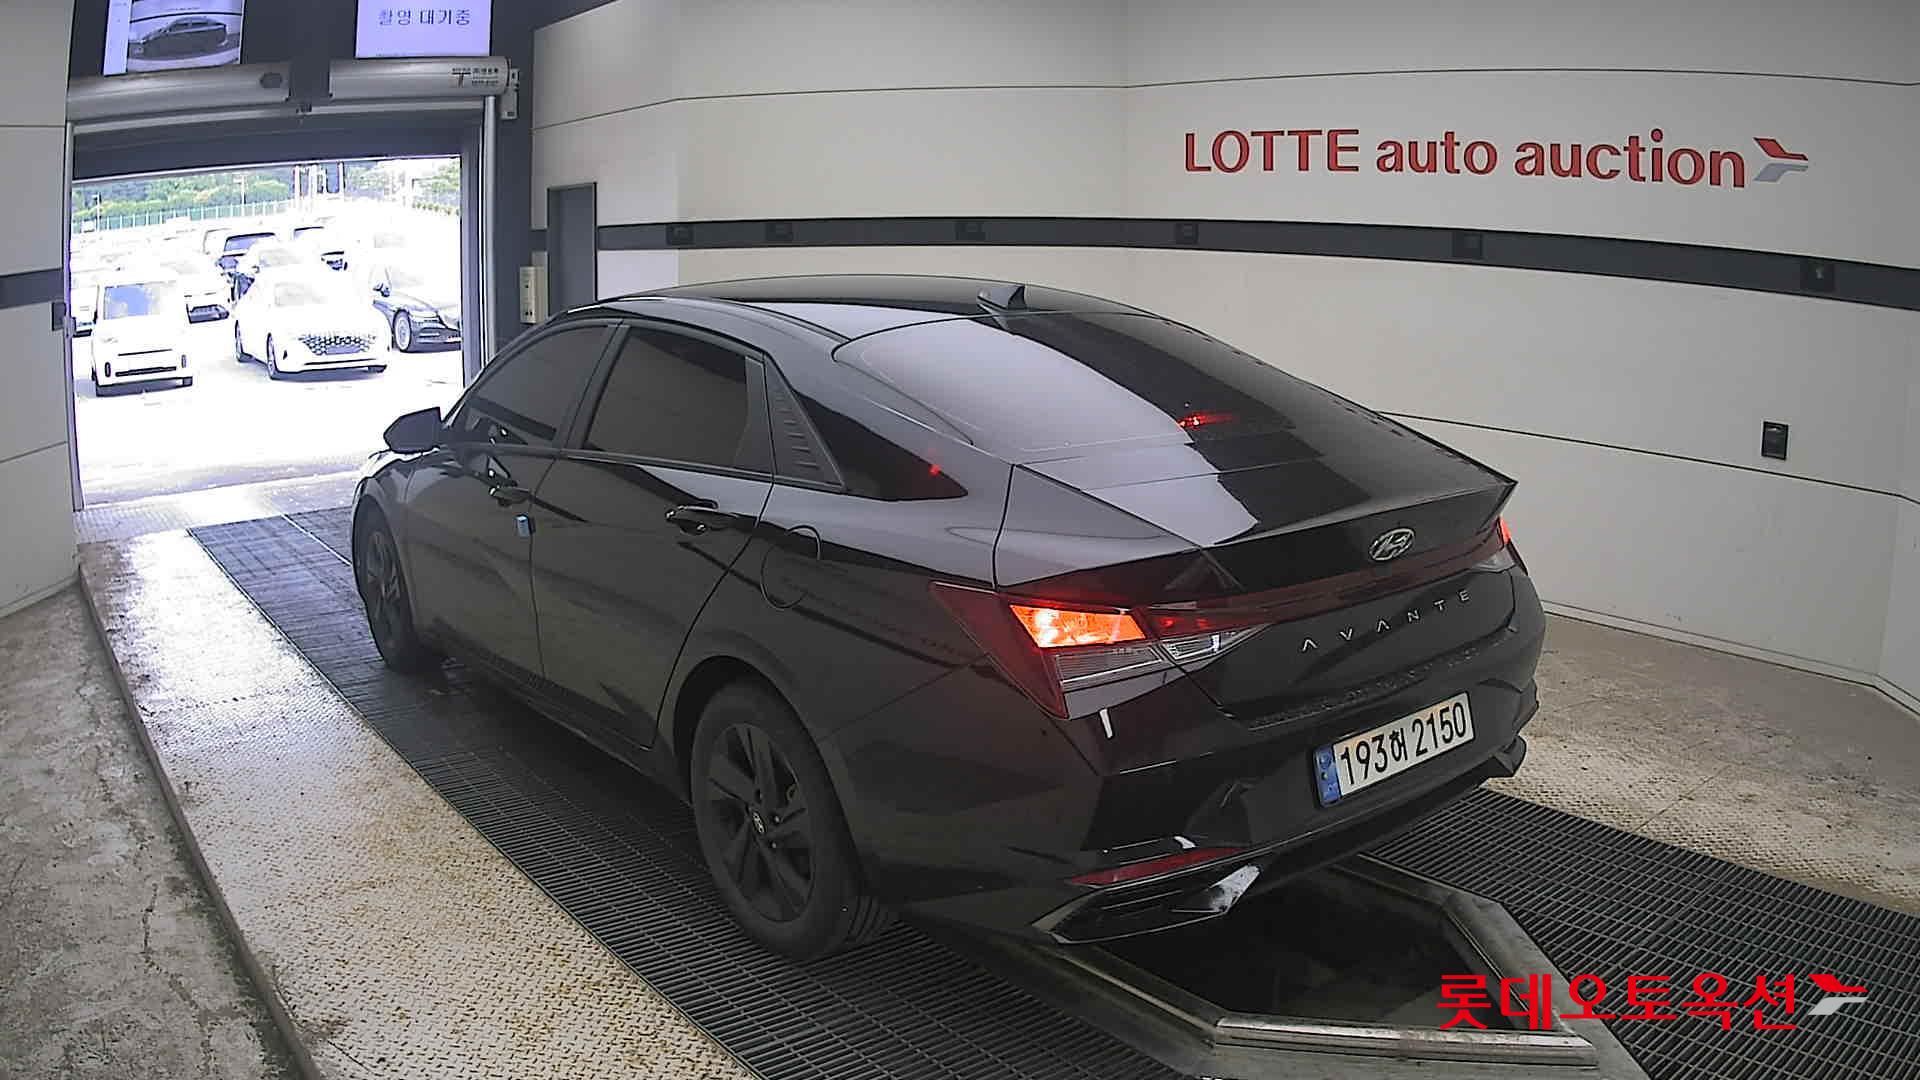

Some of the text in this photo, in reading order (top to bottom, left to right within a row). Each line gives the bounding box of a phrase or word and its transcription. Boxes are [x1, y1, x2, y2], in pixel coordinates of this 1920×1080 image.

[419, 8, 470, 26] 대기중
[1185, 128, 1745, 188] LOTTE auto auction
[1301, 589, 1470, 652] AVANTE
[1340, 702, 1467, 785] 193허 2150
